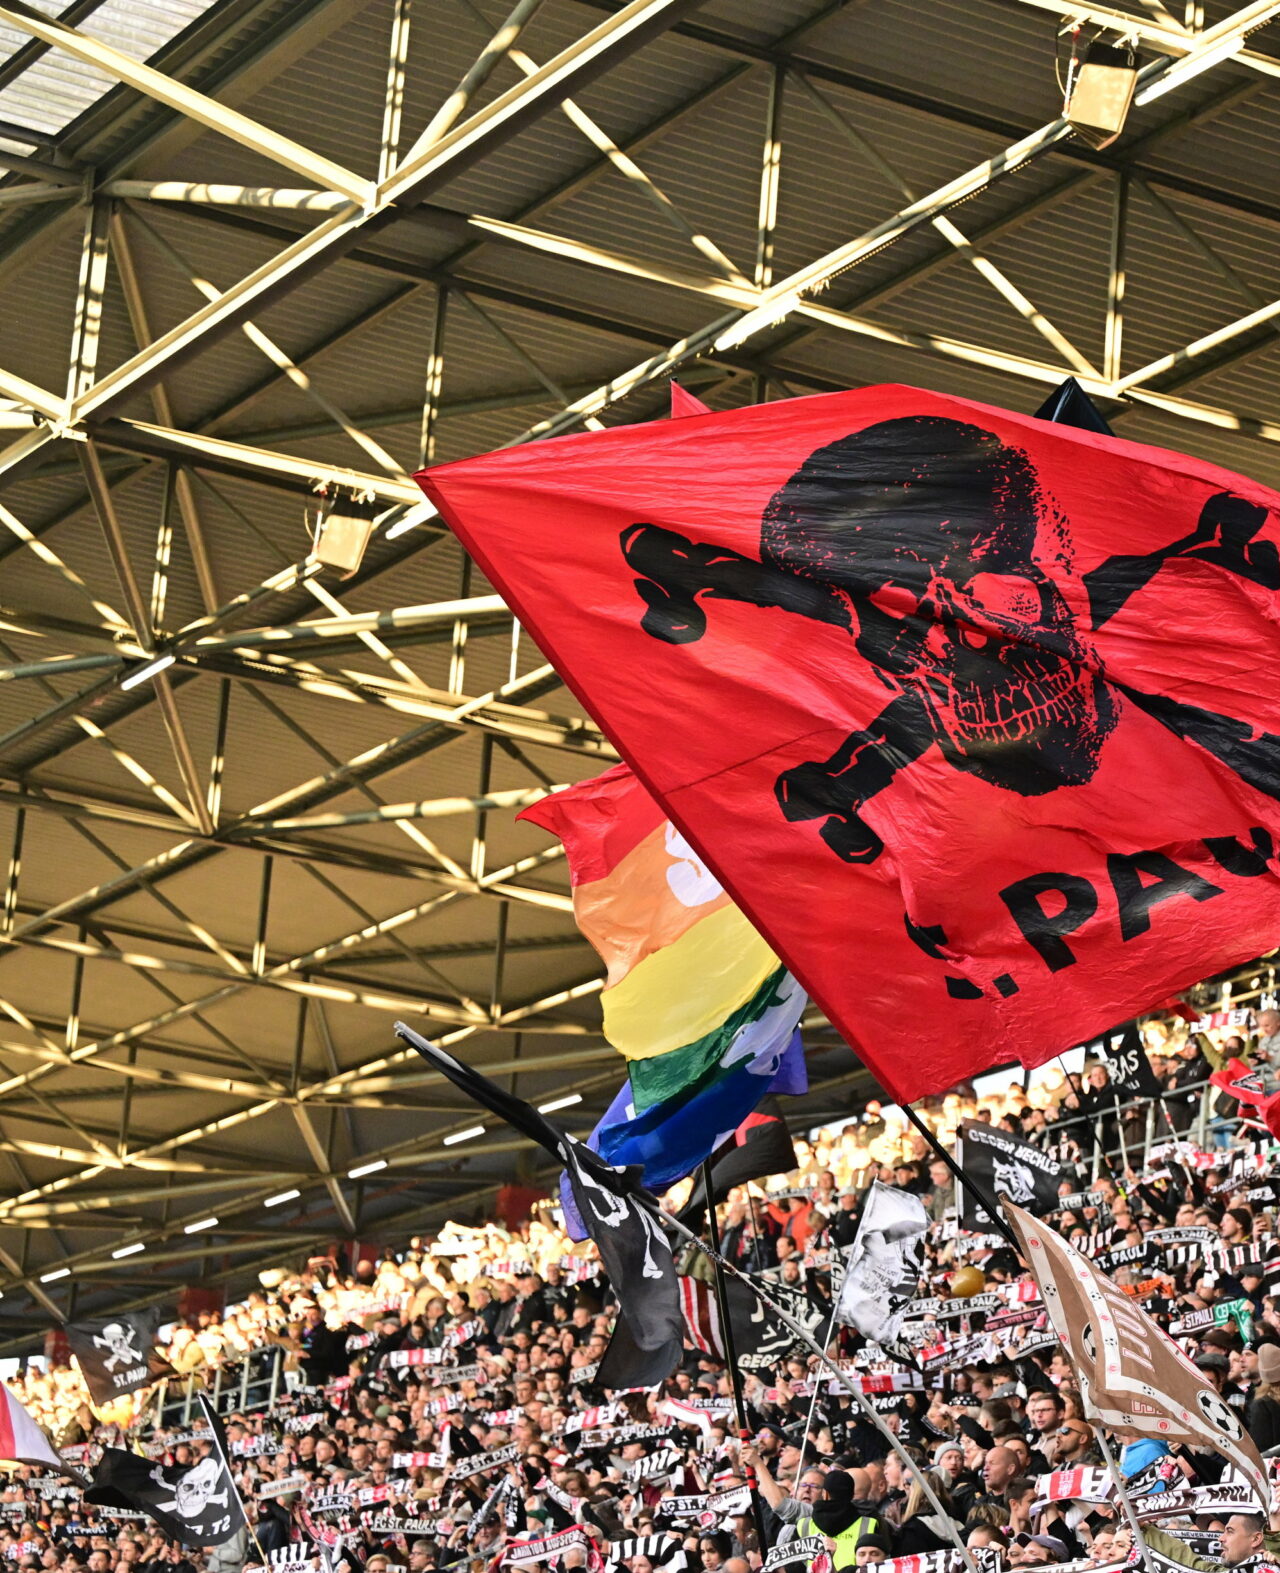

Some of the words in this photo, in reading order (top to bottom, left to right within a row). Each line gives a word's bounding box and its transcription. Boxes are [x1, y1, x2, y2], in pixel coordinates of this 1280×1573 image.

[1111, 1244, 1148, 1265] PAULI
[677, 1498, 698, 1510] ST.
[373, 1517, 389, 1529] FC
[388, 1517, 404, 1529] ST.
[404, 1517, 436, 1530] PAULI
[1179, 1531, 1208, 1539] NEVER
[765, 1551, 781, 1566] FC
[780, 1547, 794, 1559] ST.
